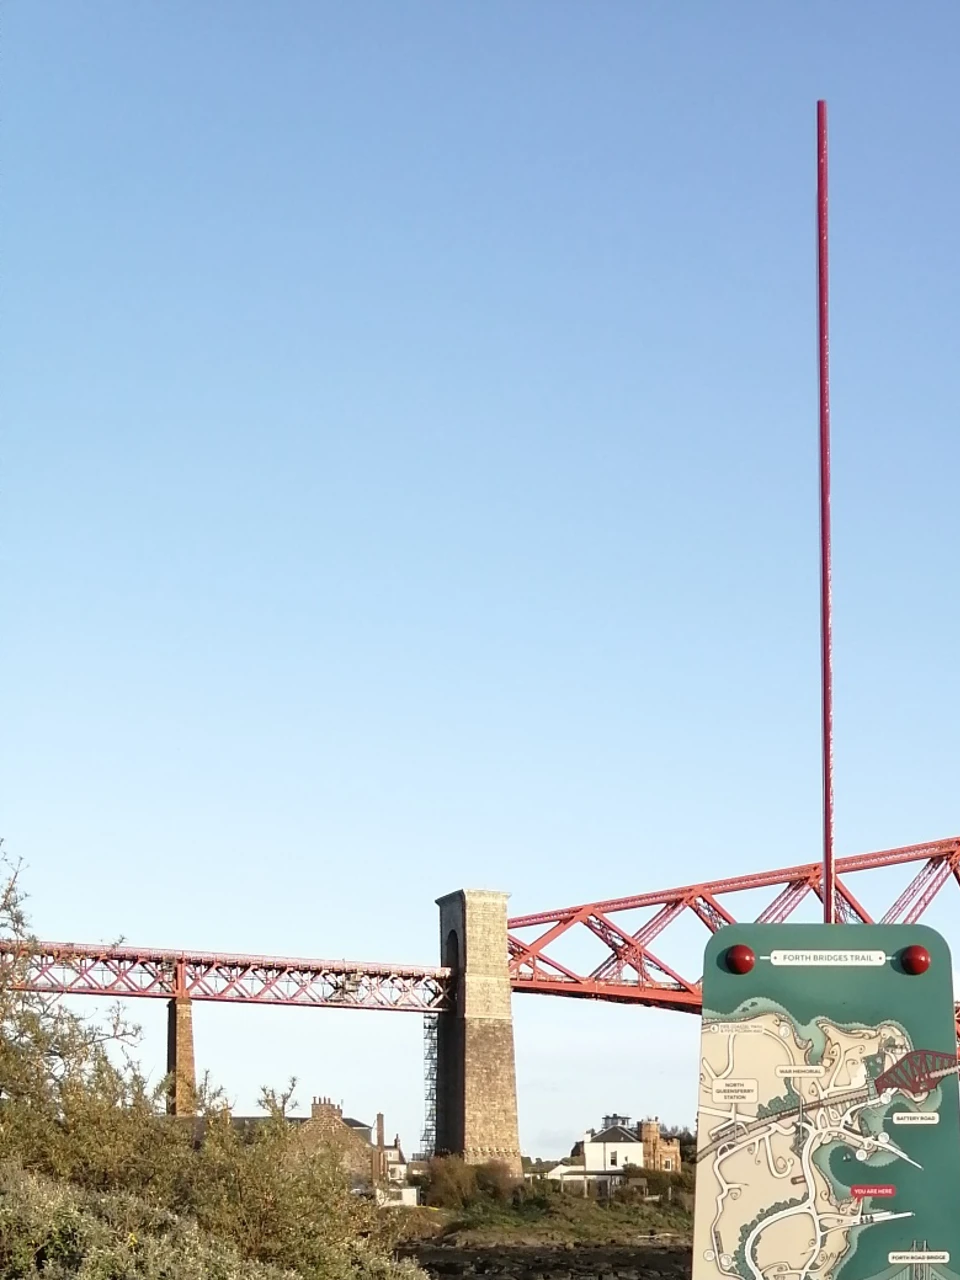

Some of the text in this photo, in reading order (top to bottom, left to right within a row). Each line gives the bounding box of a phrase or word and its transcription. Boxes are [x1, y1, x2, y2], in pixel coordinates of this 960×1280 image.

[783, 954, 874, 962] FORTH BRIDGES TRAIL
